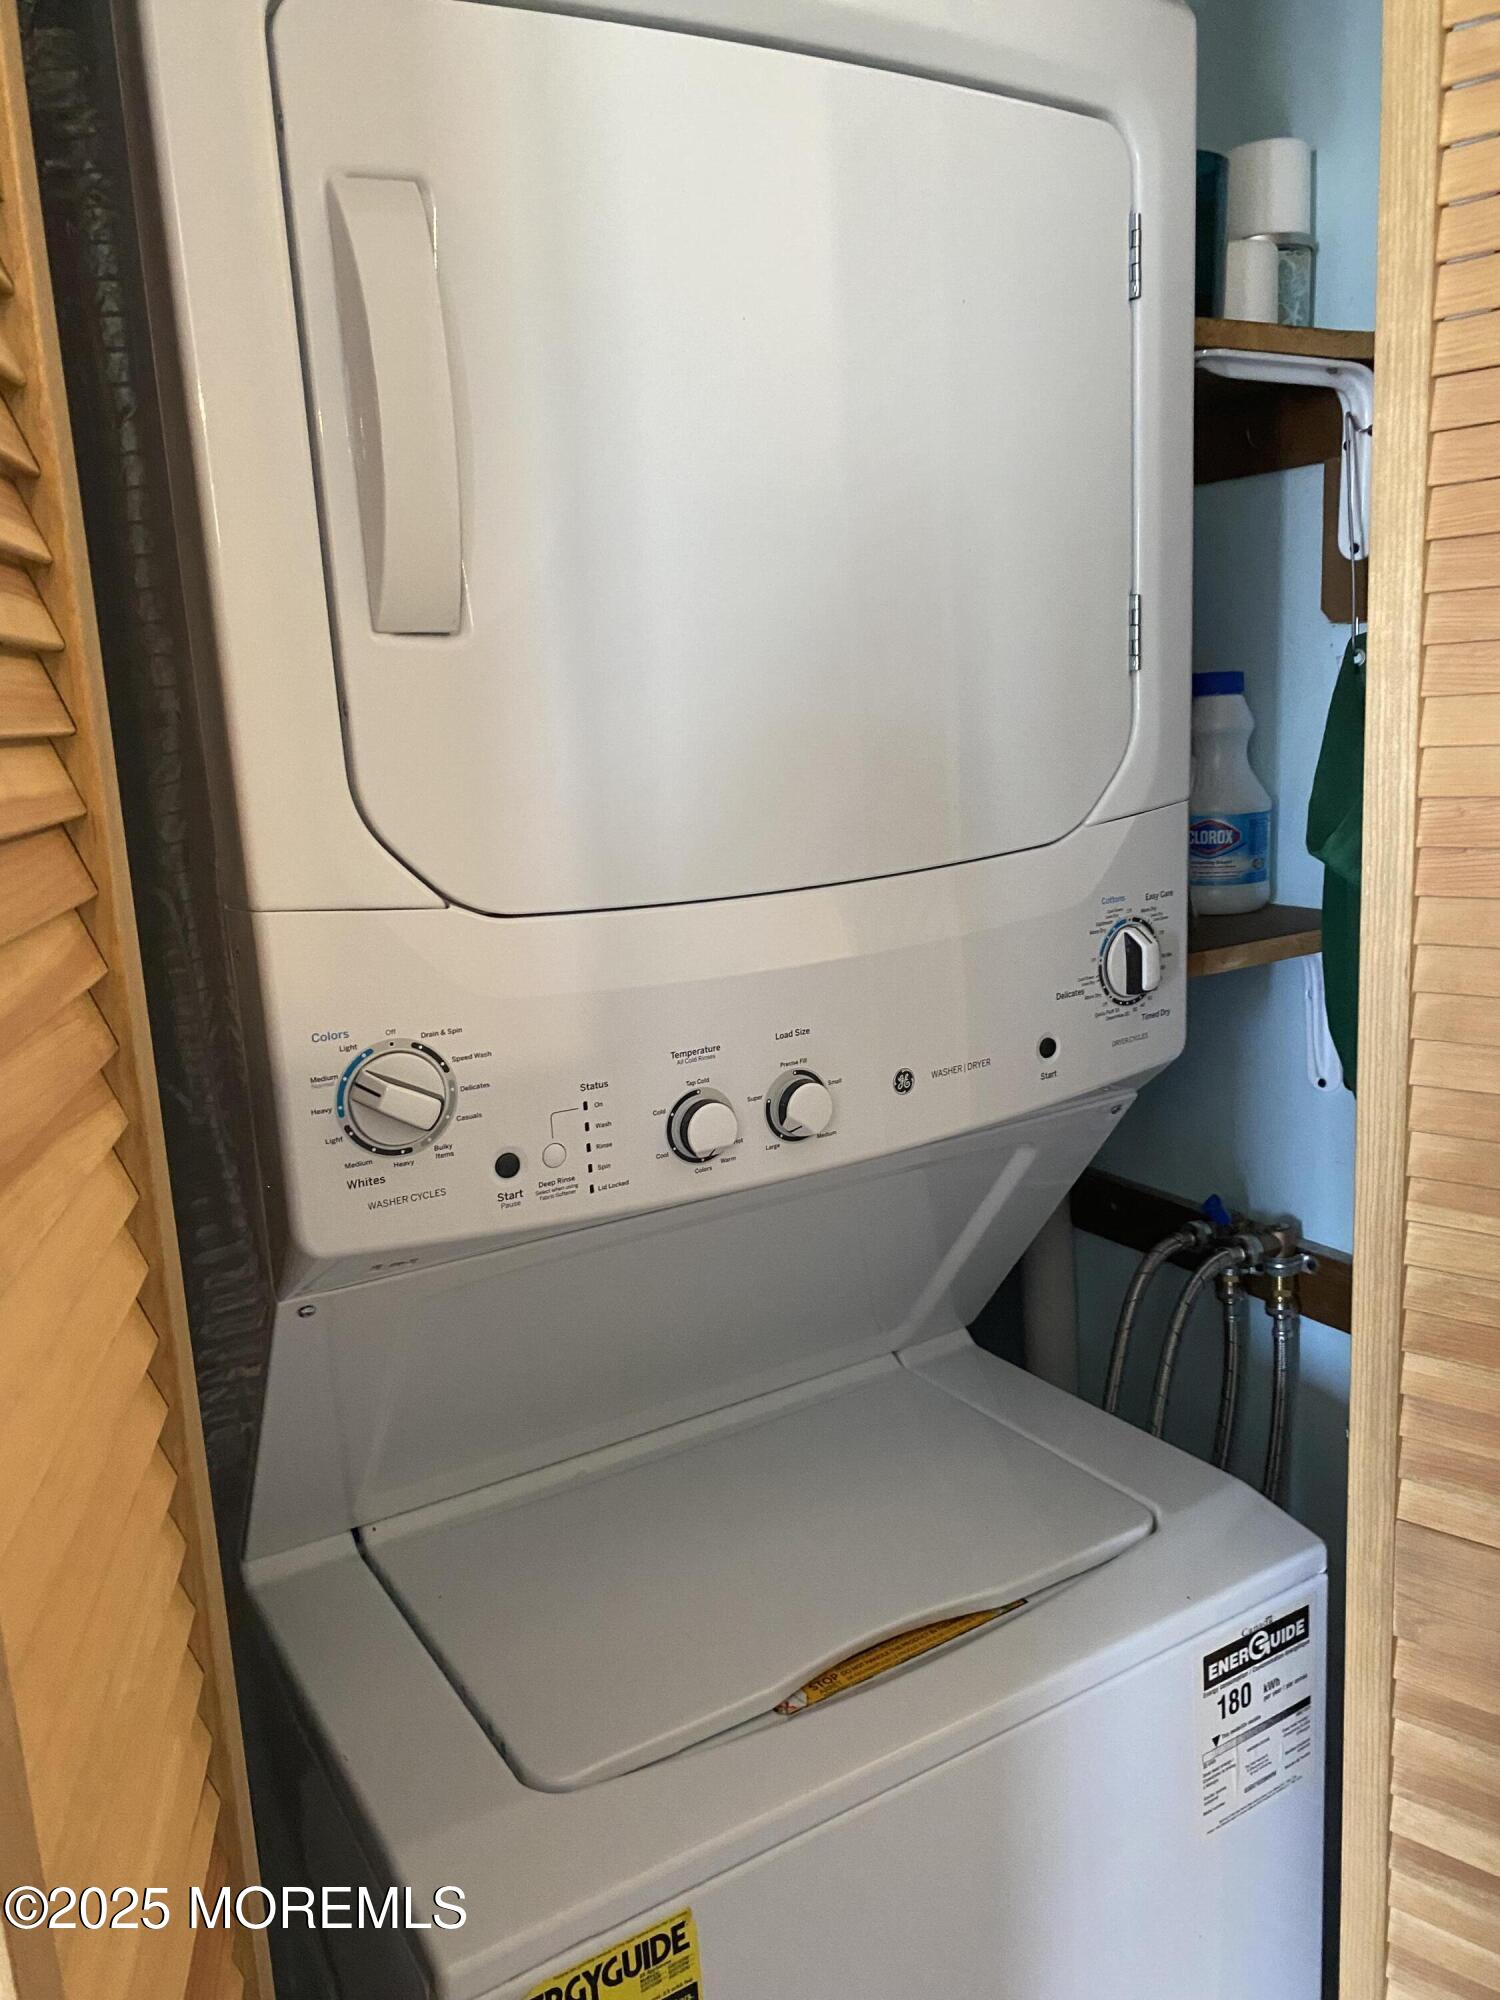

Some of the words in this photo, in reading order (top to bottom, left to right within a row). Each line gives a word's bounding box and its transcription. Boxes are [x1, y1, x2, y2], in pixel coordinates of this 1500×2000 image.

[1189, 830, 1233, 845] CLOROX
[1056, 989, 1085, 1001] Delicates
[1141, 1011, 1159, 1020] Timed
[1160, 1008, 1170, 1017] Dry
[311, 1031, 350, 1043] Colors
[385, 1028, 396, 1036] Off
[421, 1031, 439, 1039] Drain
[447, 1027, 463, 1036] Spin
[775, 1032, 793, 1040] Load
[795, 1028, 810, 1037] Size
[339, 1044, 357, 1052] Light
[671, 1044, 720, 1059] Temperature
[452, 1054, 472, 1064] Speed
[473, 1051, 492, 1059] Wash
[931, 1065, 962, 1079] WASHER
[967, 1058, 991, 1072] DRYER
[310, 1074, 338, 1083] Medium
[1040, 1070, 1057, 1081] Start
[460, 1082, 490, 1092] Delicates
[580, 1080, 609, 1092] Status
[310, 1107, 332, 1116] Heavy
[653, 1108, 666, 1116] Cold
[456, 1112, 482, 1122] Casuals
[595, 1121, 612, 1129] Wash
[325, 1136, 343, 1145] Light
[434, 1143, 453, 1152] Bulky
[596, 1142, 613, 1150] Rinse
[765, 1143, 780, 1151] Large
[435, 1151, 454, 1159] Items
[344, 1160, 372, 1169] Medium
[393, 1160, 414, 1168] Heavy
[598, 1163, 611, 1171] Spin
[695, 1166, 712, 1174] Colors
[347, 1176, 386, 1190] Whites
[538, 1180, 556, 1189] Deep
[557, 1176, 575, 1184] Rinse
[608, 1180, 629, 1189] Locked
[367, 1195, 408, 1210] WASHER
[410, 1187, 447, 1202] CYCLES
[497, 1189, 524, 1202] Start
[501, 1201, 521, 1209] Pause
[1208, 1618, 1305, 1681] ENERGUIDE
[809, 1673, 838, 1690] STOP
[1217, 1682, 1251, 1720] 180
[529, 1921, 690, 2000] GYGUIDE
